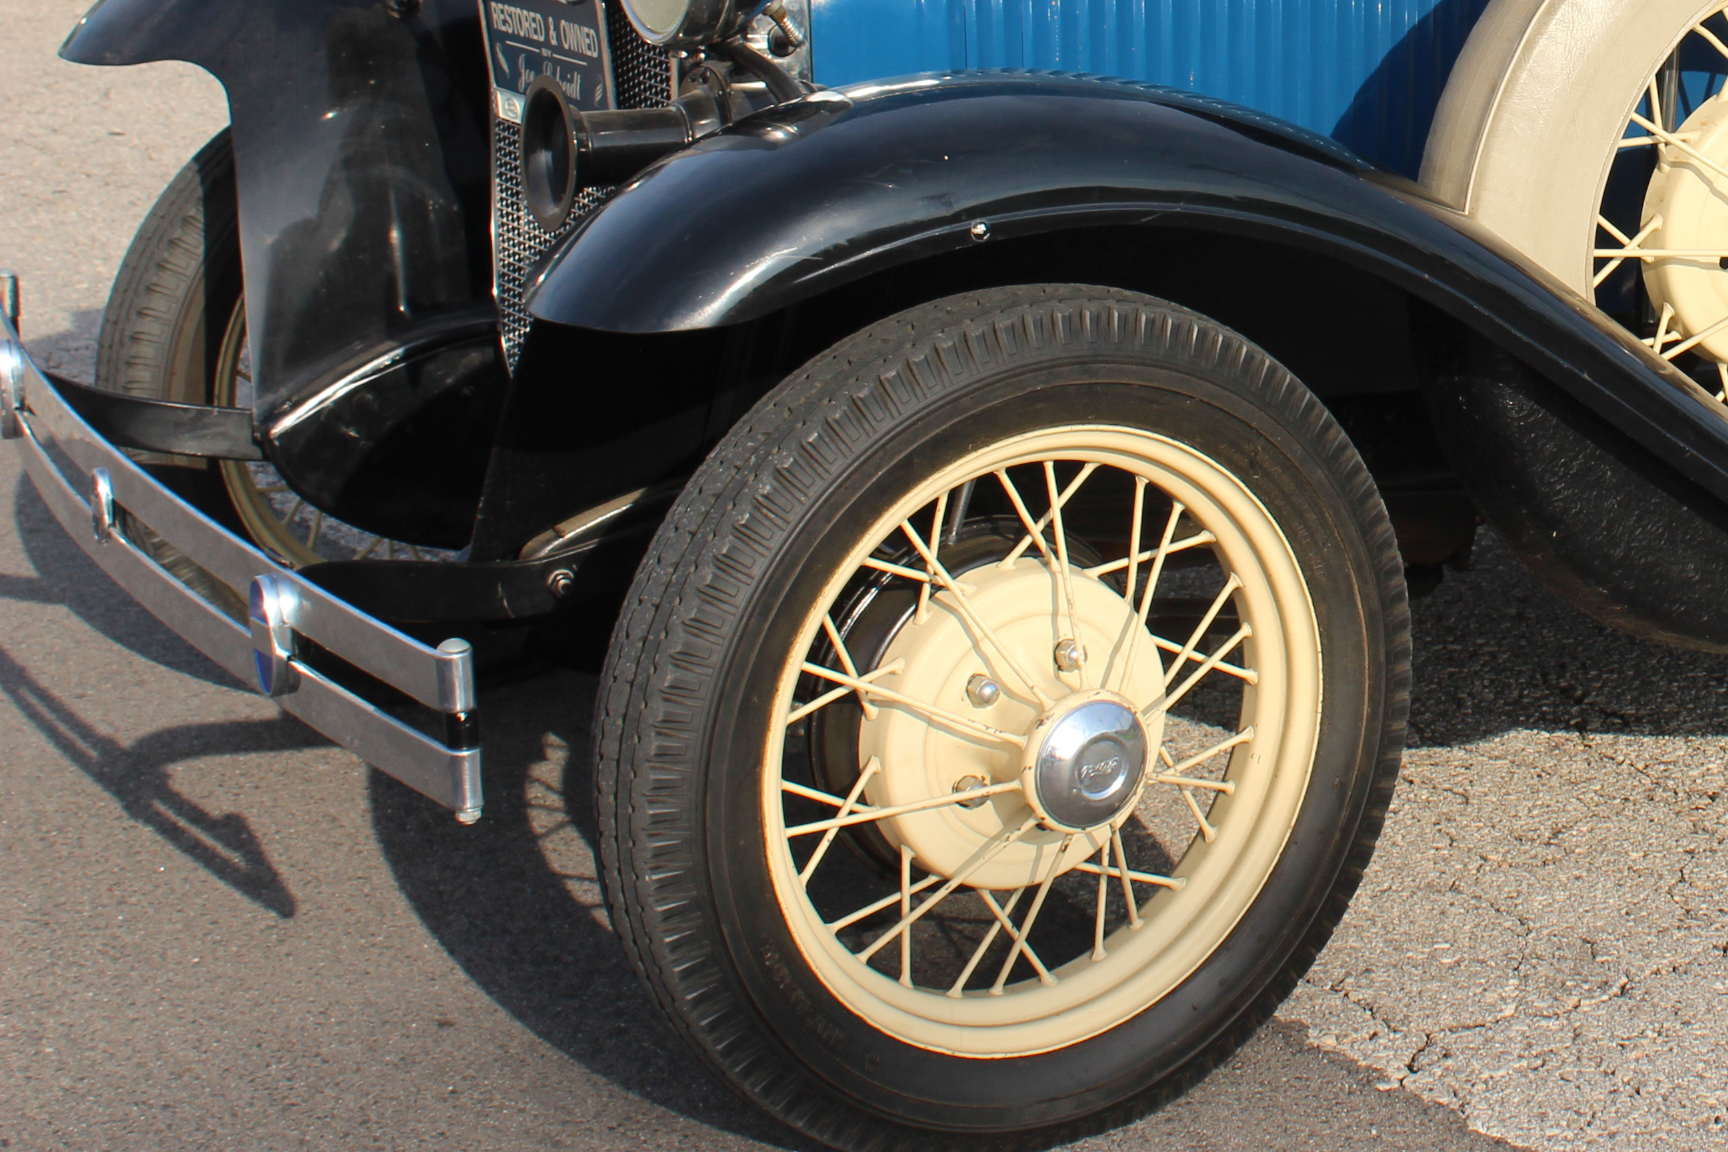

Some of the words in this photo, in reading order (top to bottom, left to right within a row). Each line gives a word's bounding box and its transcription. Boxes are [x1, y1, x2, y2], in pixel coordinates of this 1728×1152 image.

[491, 1, 546, 42] RESTORED
[548, 16, 559, 46] &
[560, 20, 599, 58] OWNED
[541, 48, 553, 58] BY
